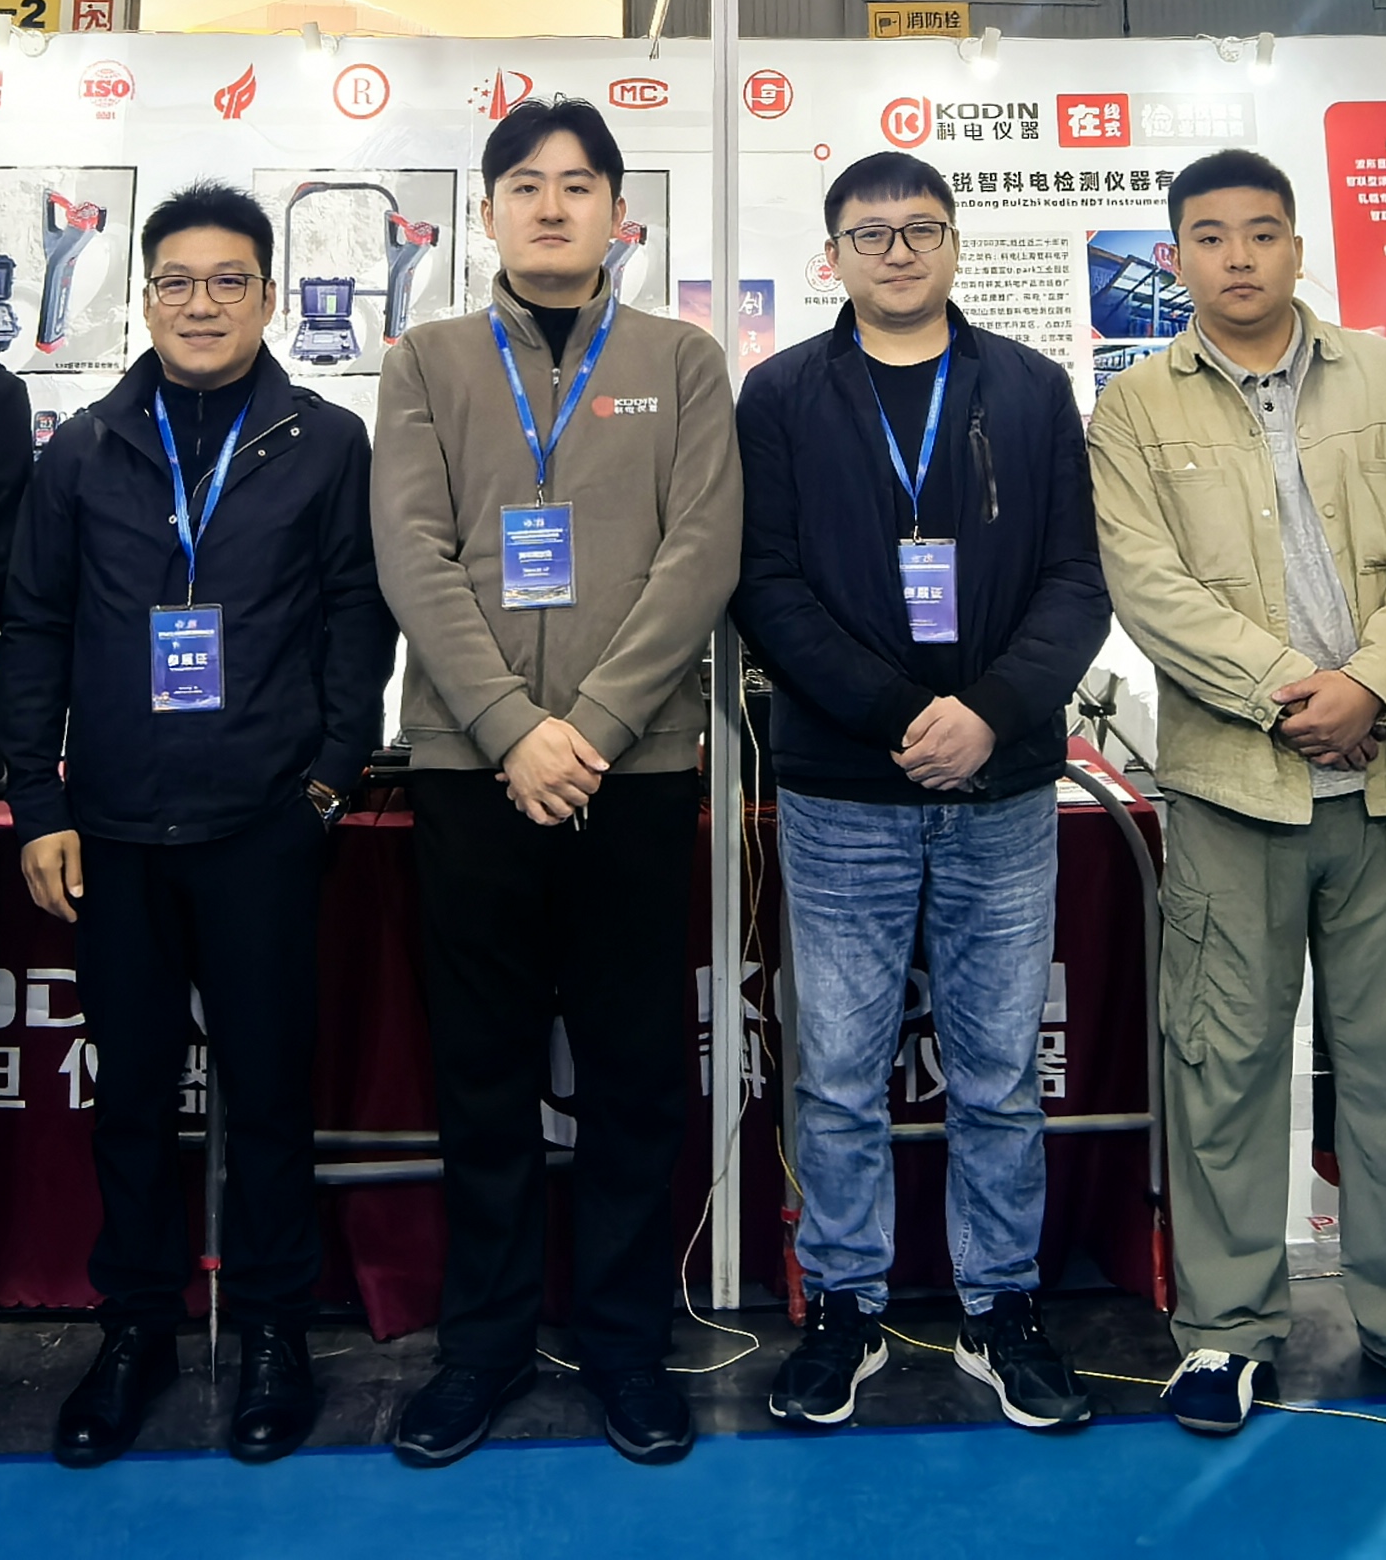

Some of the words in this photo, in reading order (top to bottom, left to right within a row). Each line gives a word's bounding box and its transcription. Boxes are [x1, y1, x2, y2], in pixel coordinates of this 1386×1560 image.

[906, 10, 962, 31] 消防栓
[83, 79, 130, 98] ISO
[936, 101, 1039, 121] KODIN
[936, 121, 1040, 141] 科电仪器
[955, 198, 999, 209] anDong
[1081, 198, 1103, 207] NDT
[1106, 198, 1168, 208] Instrumen
